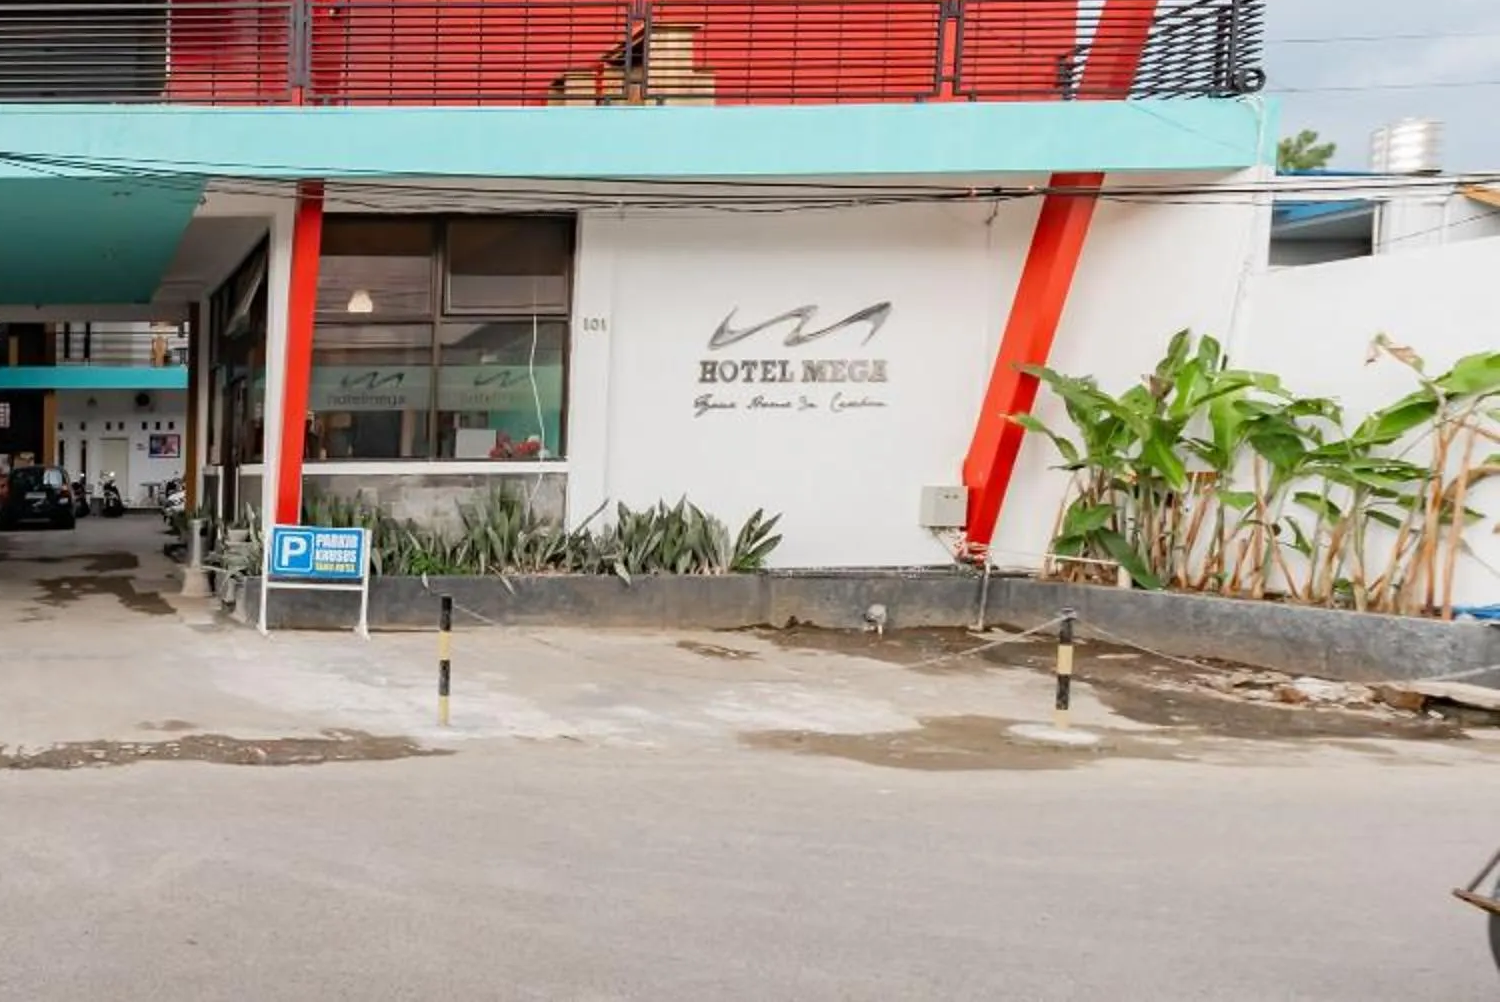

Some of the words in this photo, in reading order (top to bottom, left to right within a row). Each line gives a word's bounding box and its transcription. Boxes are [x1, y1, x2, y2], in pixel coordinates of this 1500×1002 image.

[698, 359, 794, 383] HOTEL
[800, 359, 888, 383] MEGA
[281, 536, 307, 567] P
[315, 533, 358, 549] PARKIR
